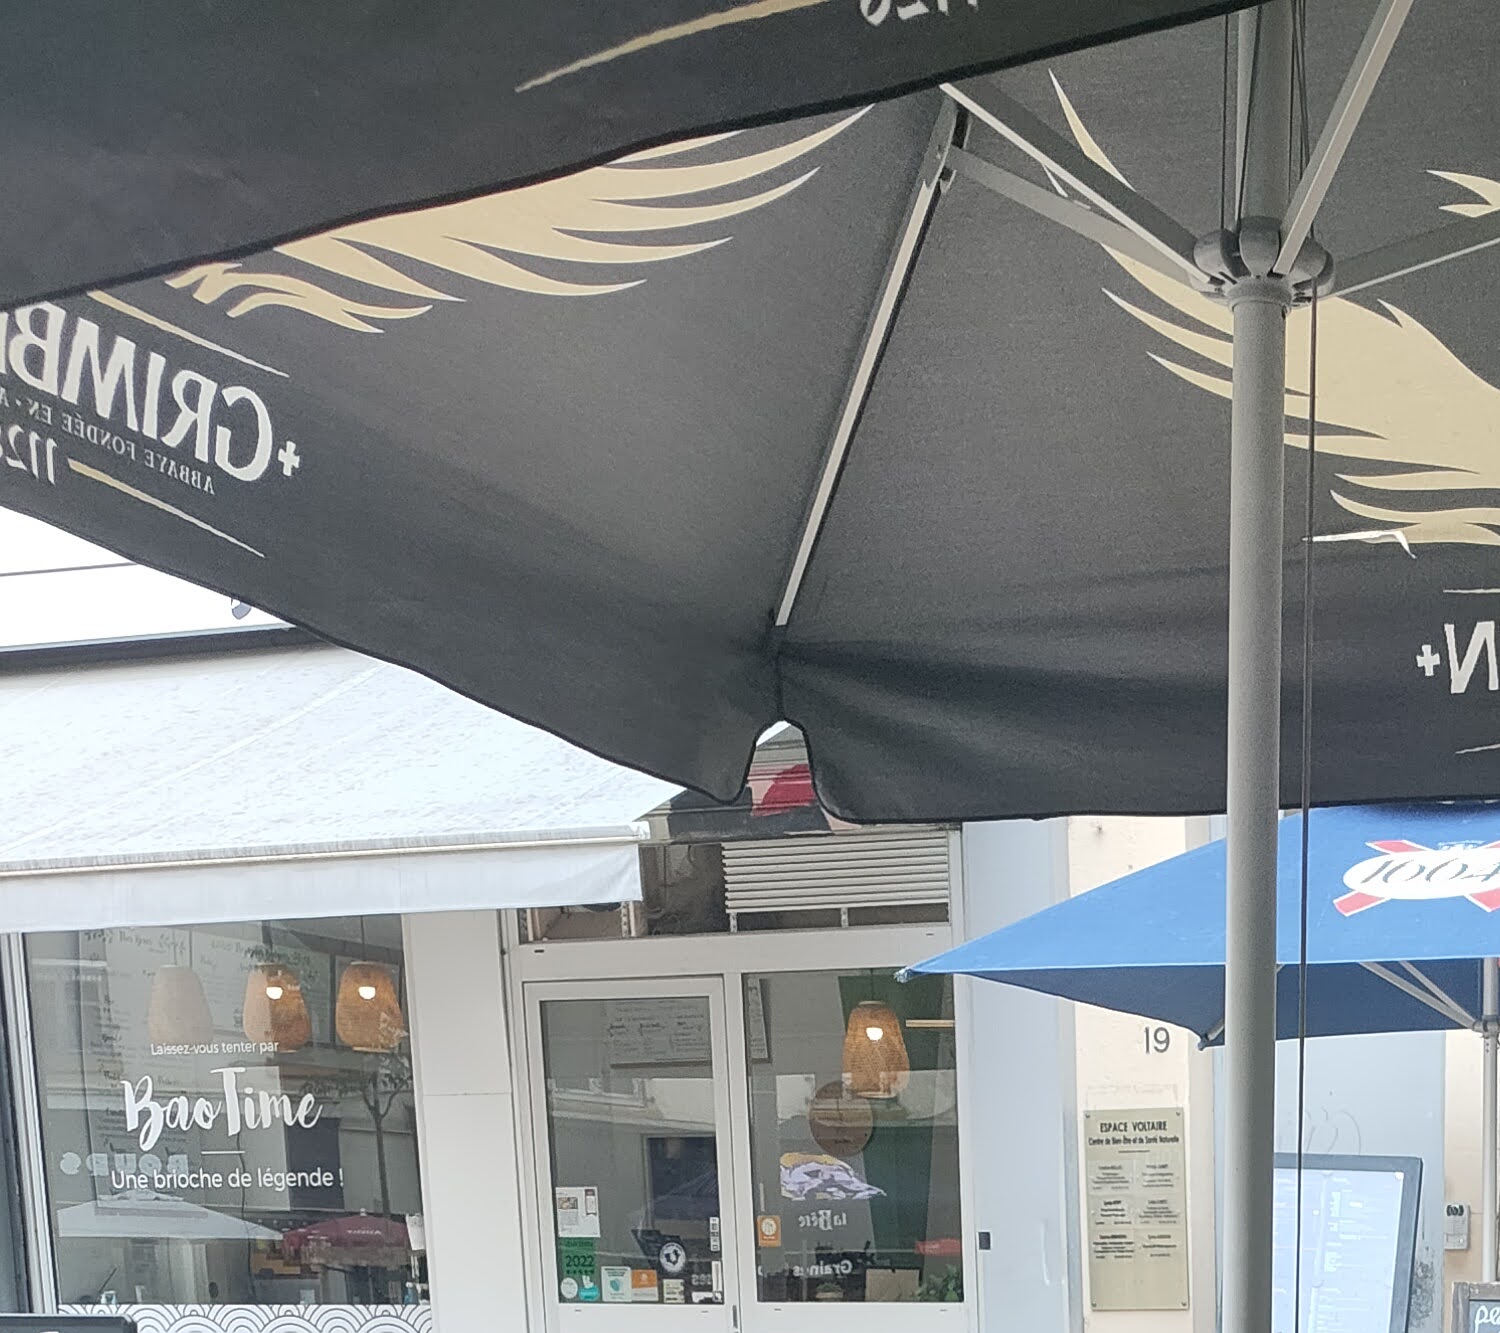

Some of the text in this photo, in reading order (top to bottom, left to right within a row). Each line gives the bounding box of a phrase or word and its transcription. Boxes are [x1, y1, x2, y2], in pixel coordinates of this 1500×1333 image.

[1143, 1027, 1171, 1054] 19
[151, 1041, 280, 1056] Laissez-vous tenter par
[1100, 1120, 1168, 1133] ESPACE VOLTAIRE
[111, 1170, 149, 1190] Une
[154, 1167, 223, 1190] brioche
[228, 1167, 252, 1189] de
[257, 1166, 334, 1193] légende
[565, 1254, 595, 1268] 2022
